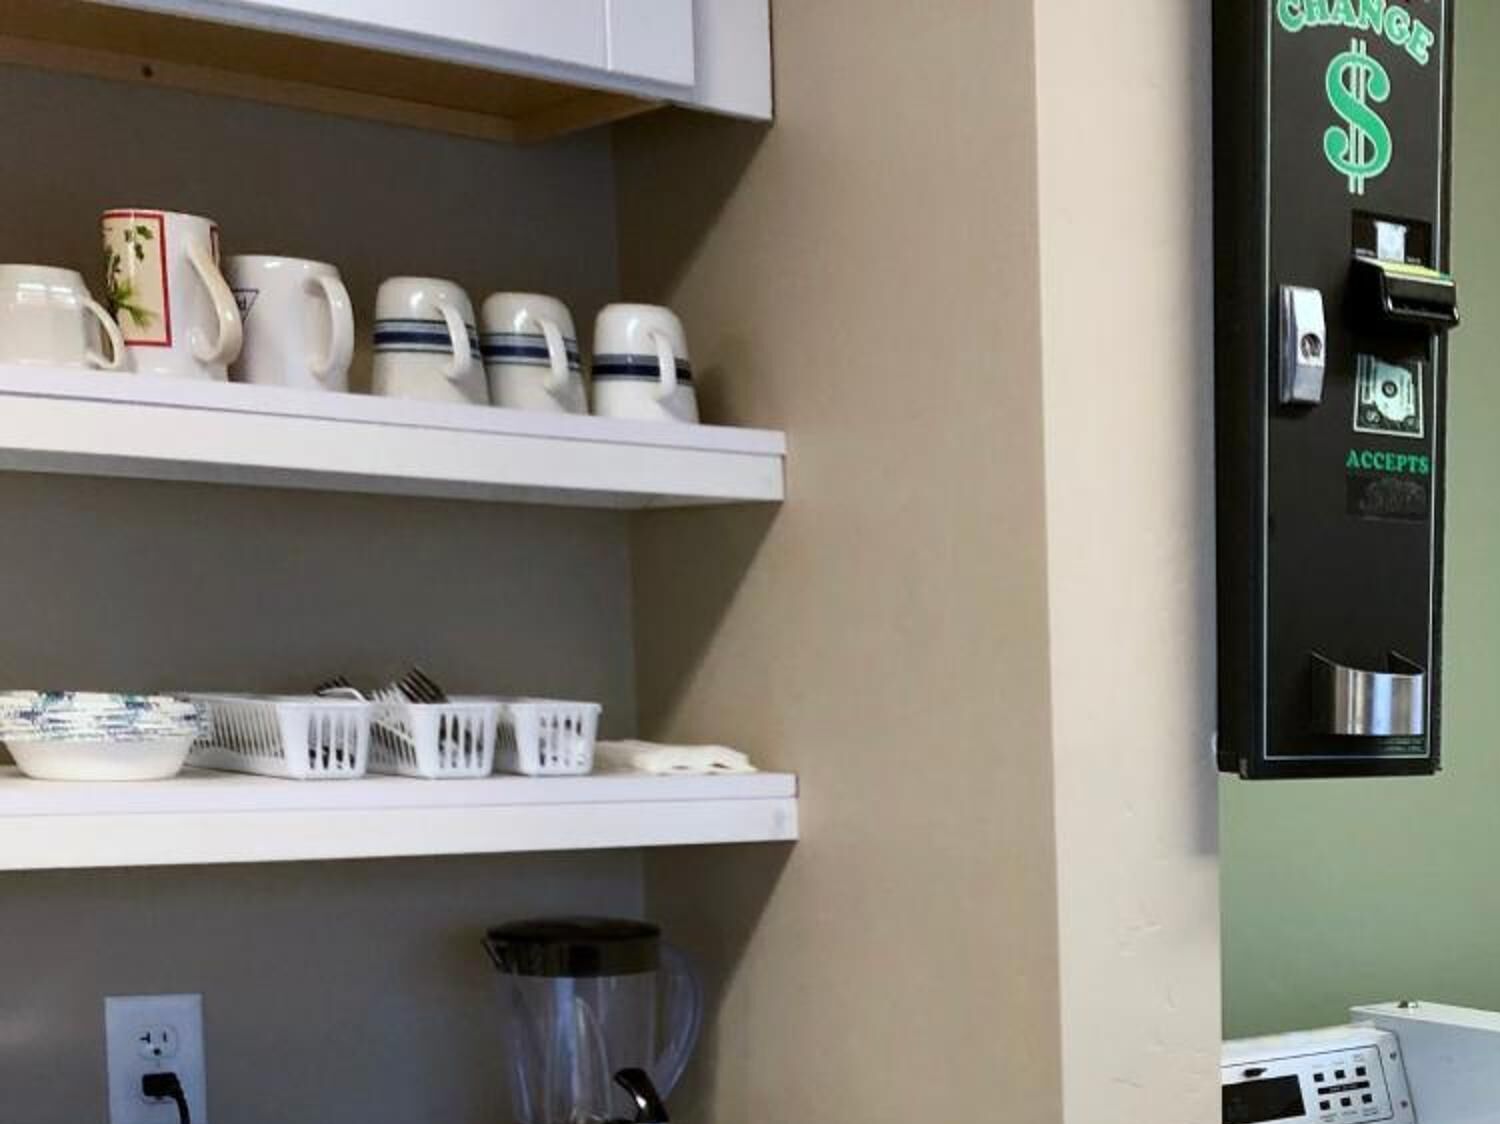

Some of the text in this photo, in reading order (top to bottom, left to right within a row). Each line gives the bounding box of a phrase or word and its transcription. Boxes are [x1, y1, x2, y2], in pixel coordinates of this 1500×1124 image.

[1276, 0, 1435, 65] CHANGE
[1323, 38, 1393, 195] $
[1345, 448, 1431, 476] ACCEPTS
